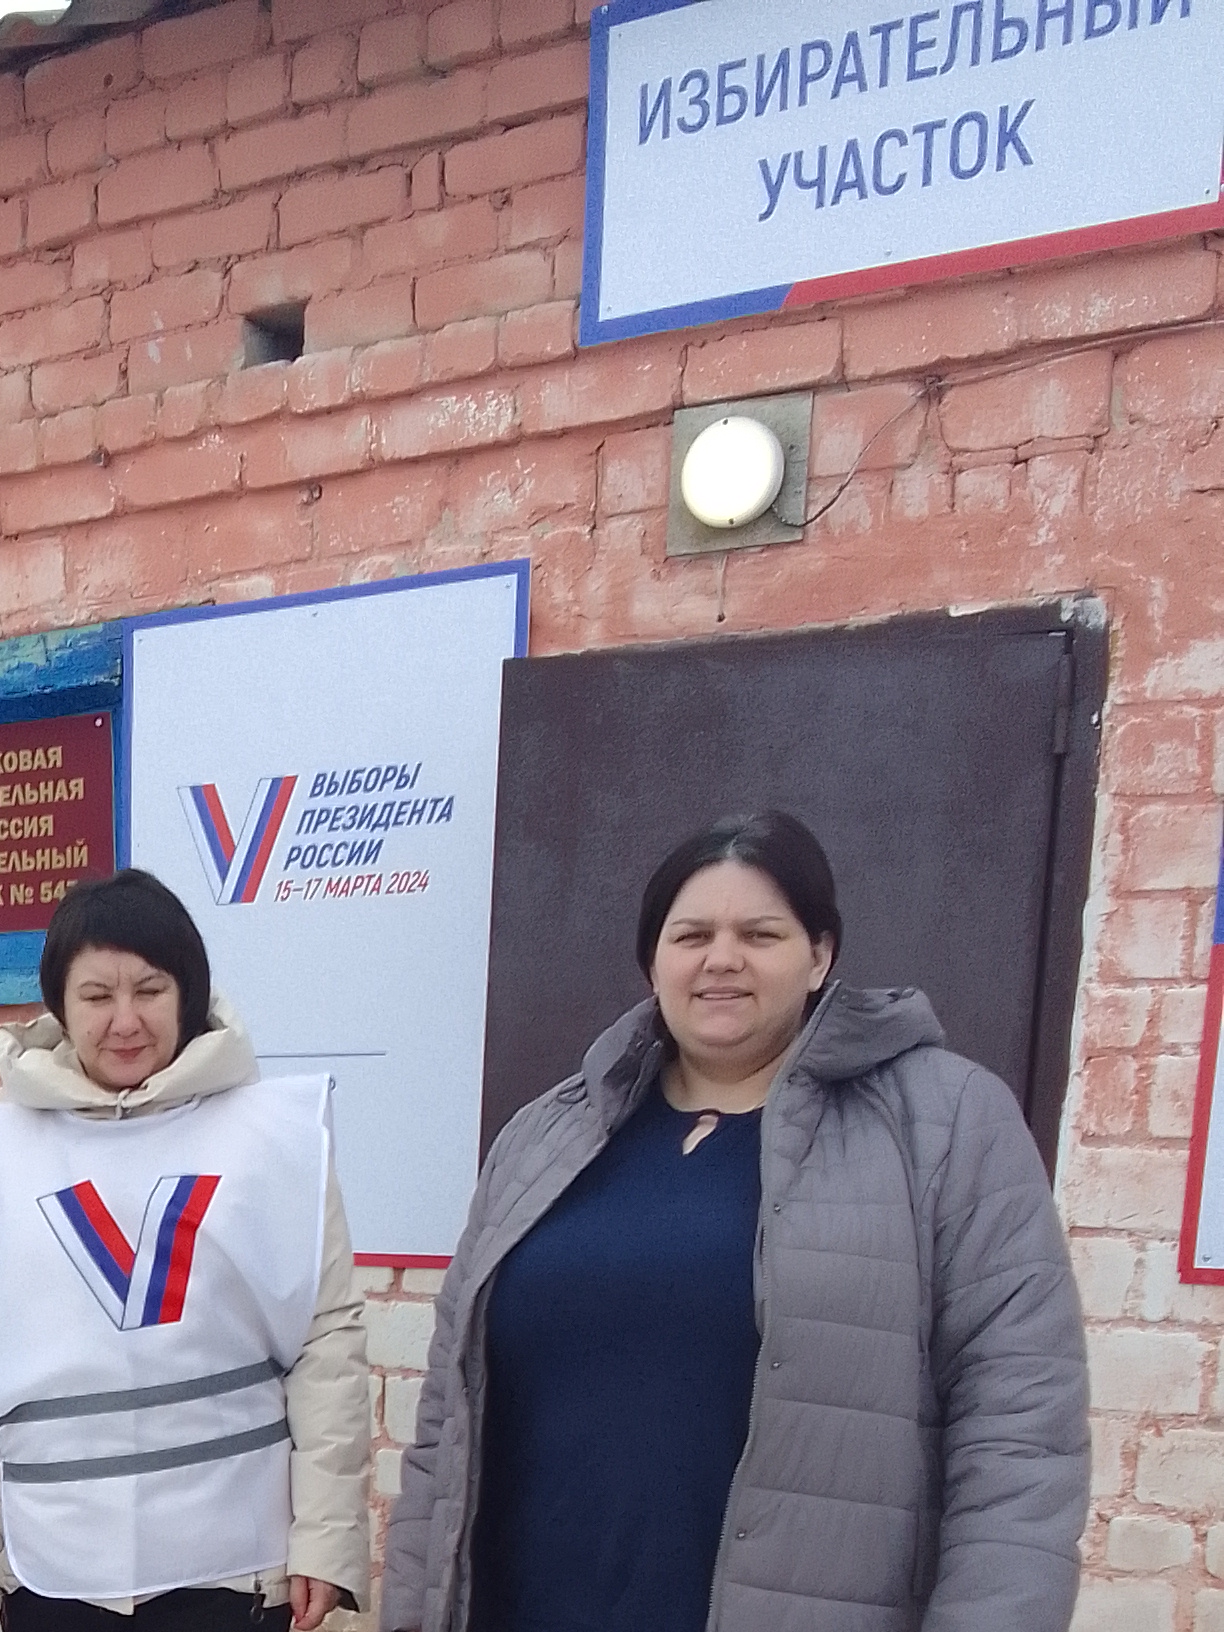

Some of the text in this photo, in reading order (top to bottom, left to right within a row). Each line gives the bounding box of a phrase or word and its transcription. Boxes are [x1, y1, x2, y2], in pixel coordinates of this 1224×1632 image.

[757, 99, 1035, 221] УЧАСТОК
[308, 762, 422, 798] ВЫБОРЫ
[295, 796, 455, 835] ПРЕЗИДЕНТА
[283, 838, 384, 871] РОССИИ
[10, 883, 34, 905] №
[324, 873, 383, 898] МАРТА
[385, 870, 429, 895] 2024
